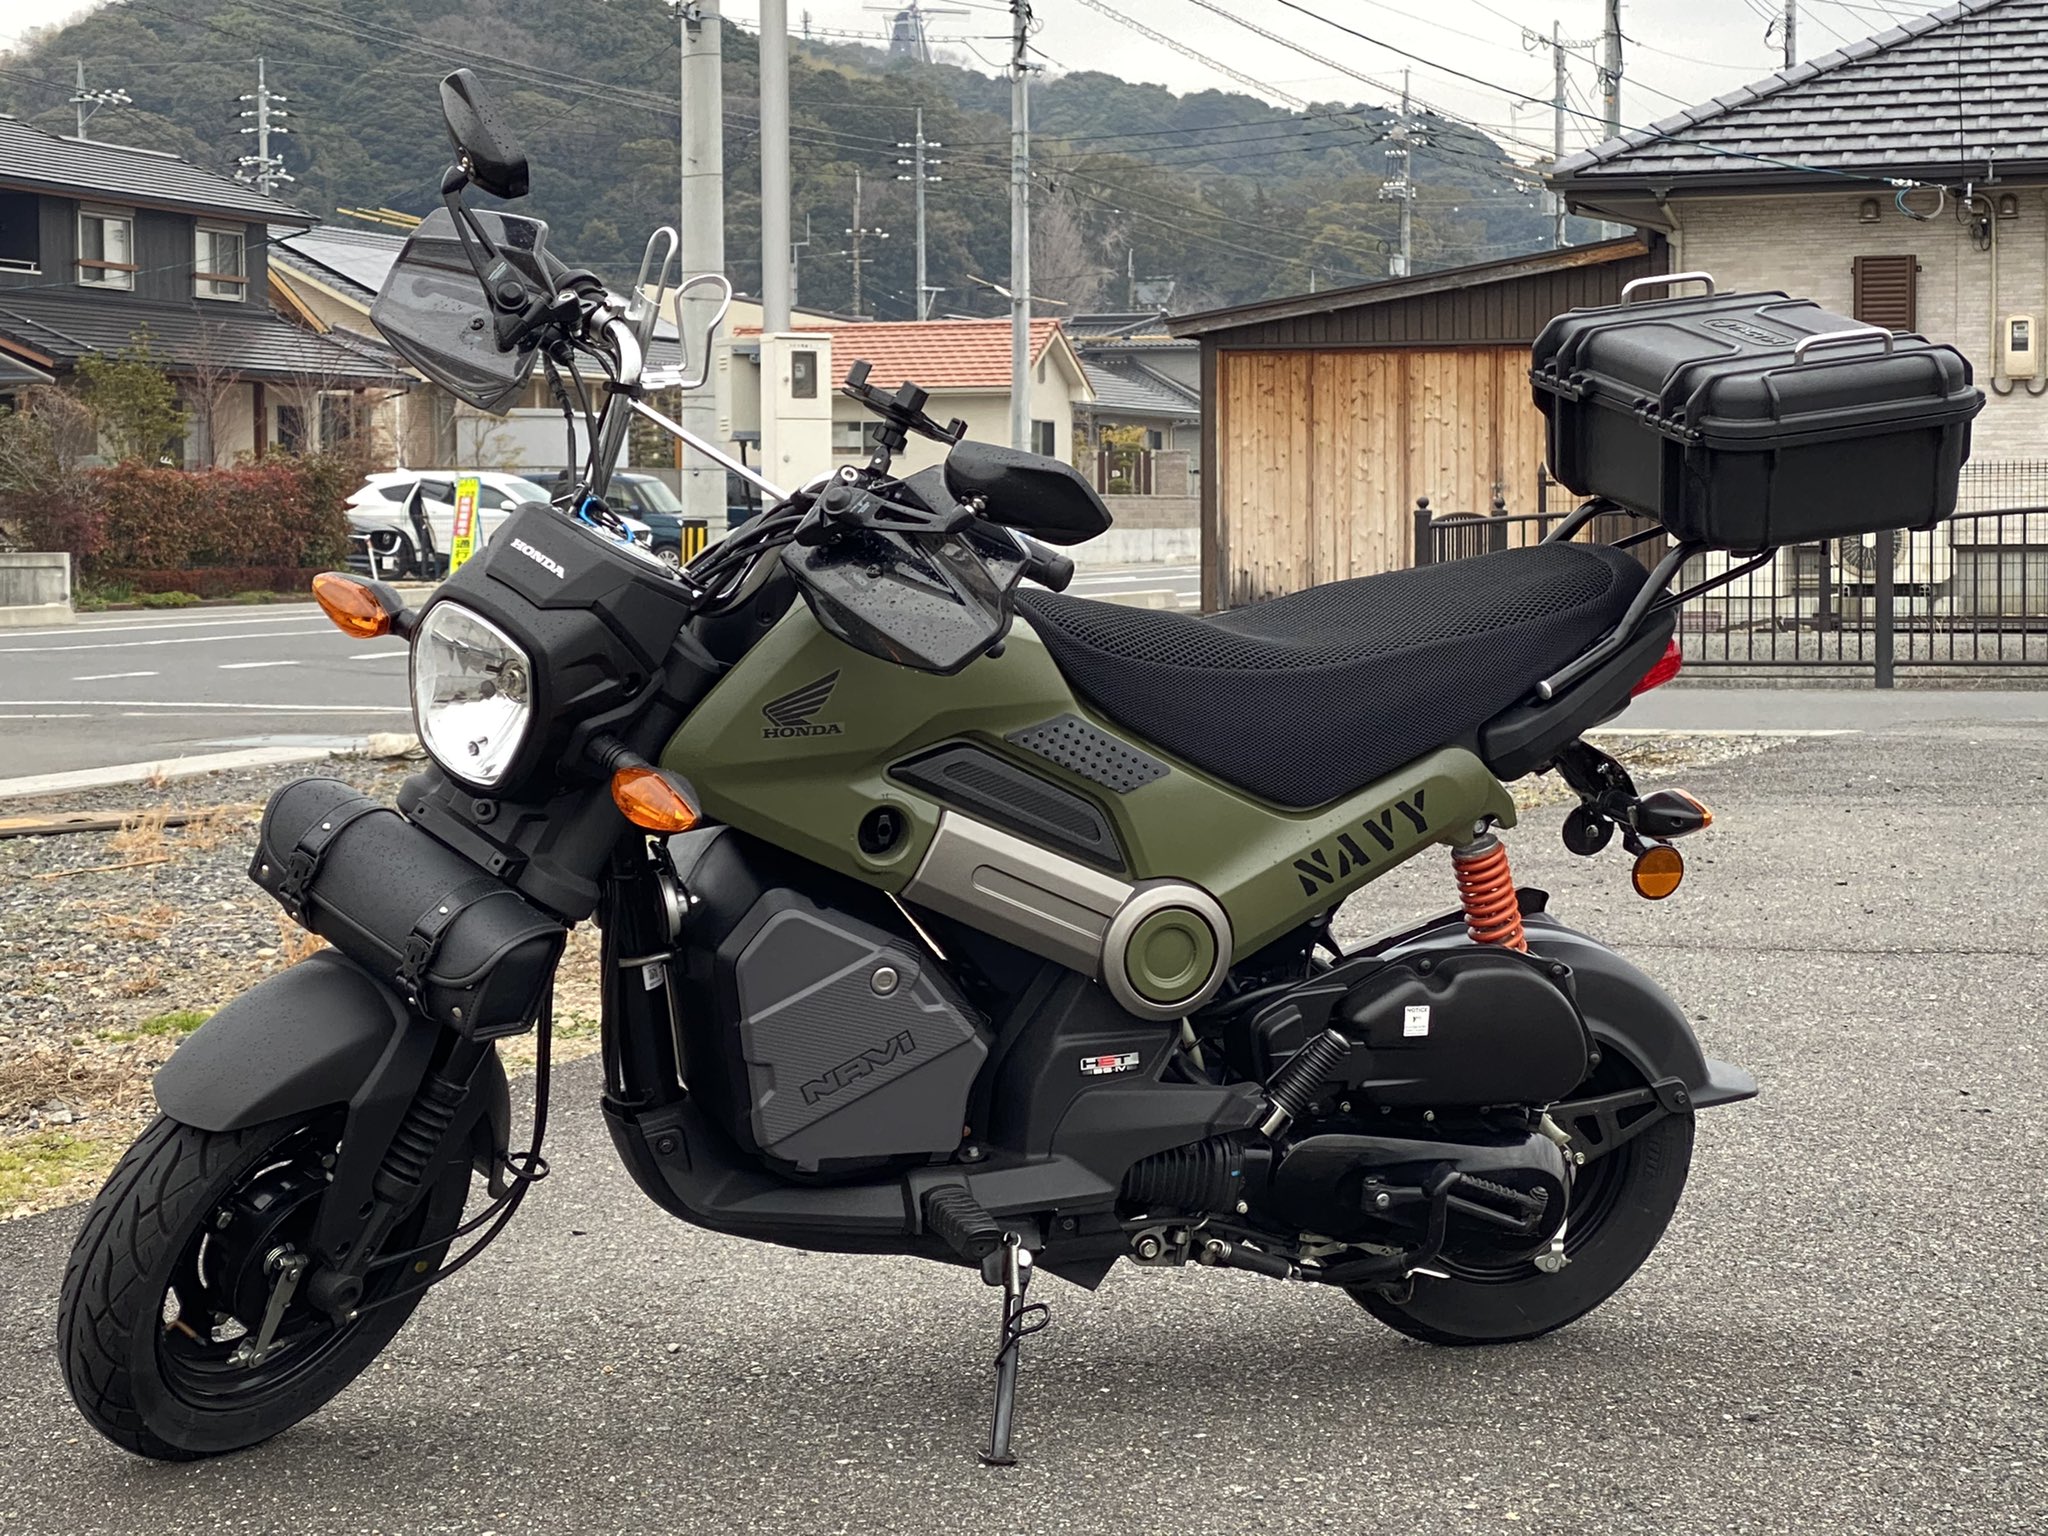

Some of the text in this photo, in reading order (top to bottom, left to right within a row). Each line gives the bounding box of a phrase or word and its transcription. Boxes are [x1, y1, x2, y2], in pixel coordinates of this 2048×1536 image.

[510, 538, 565, 579] HONDA
[762, 723, 842, 739] HONDA
[1293, 789, 1428, 897] NAVY
